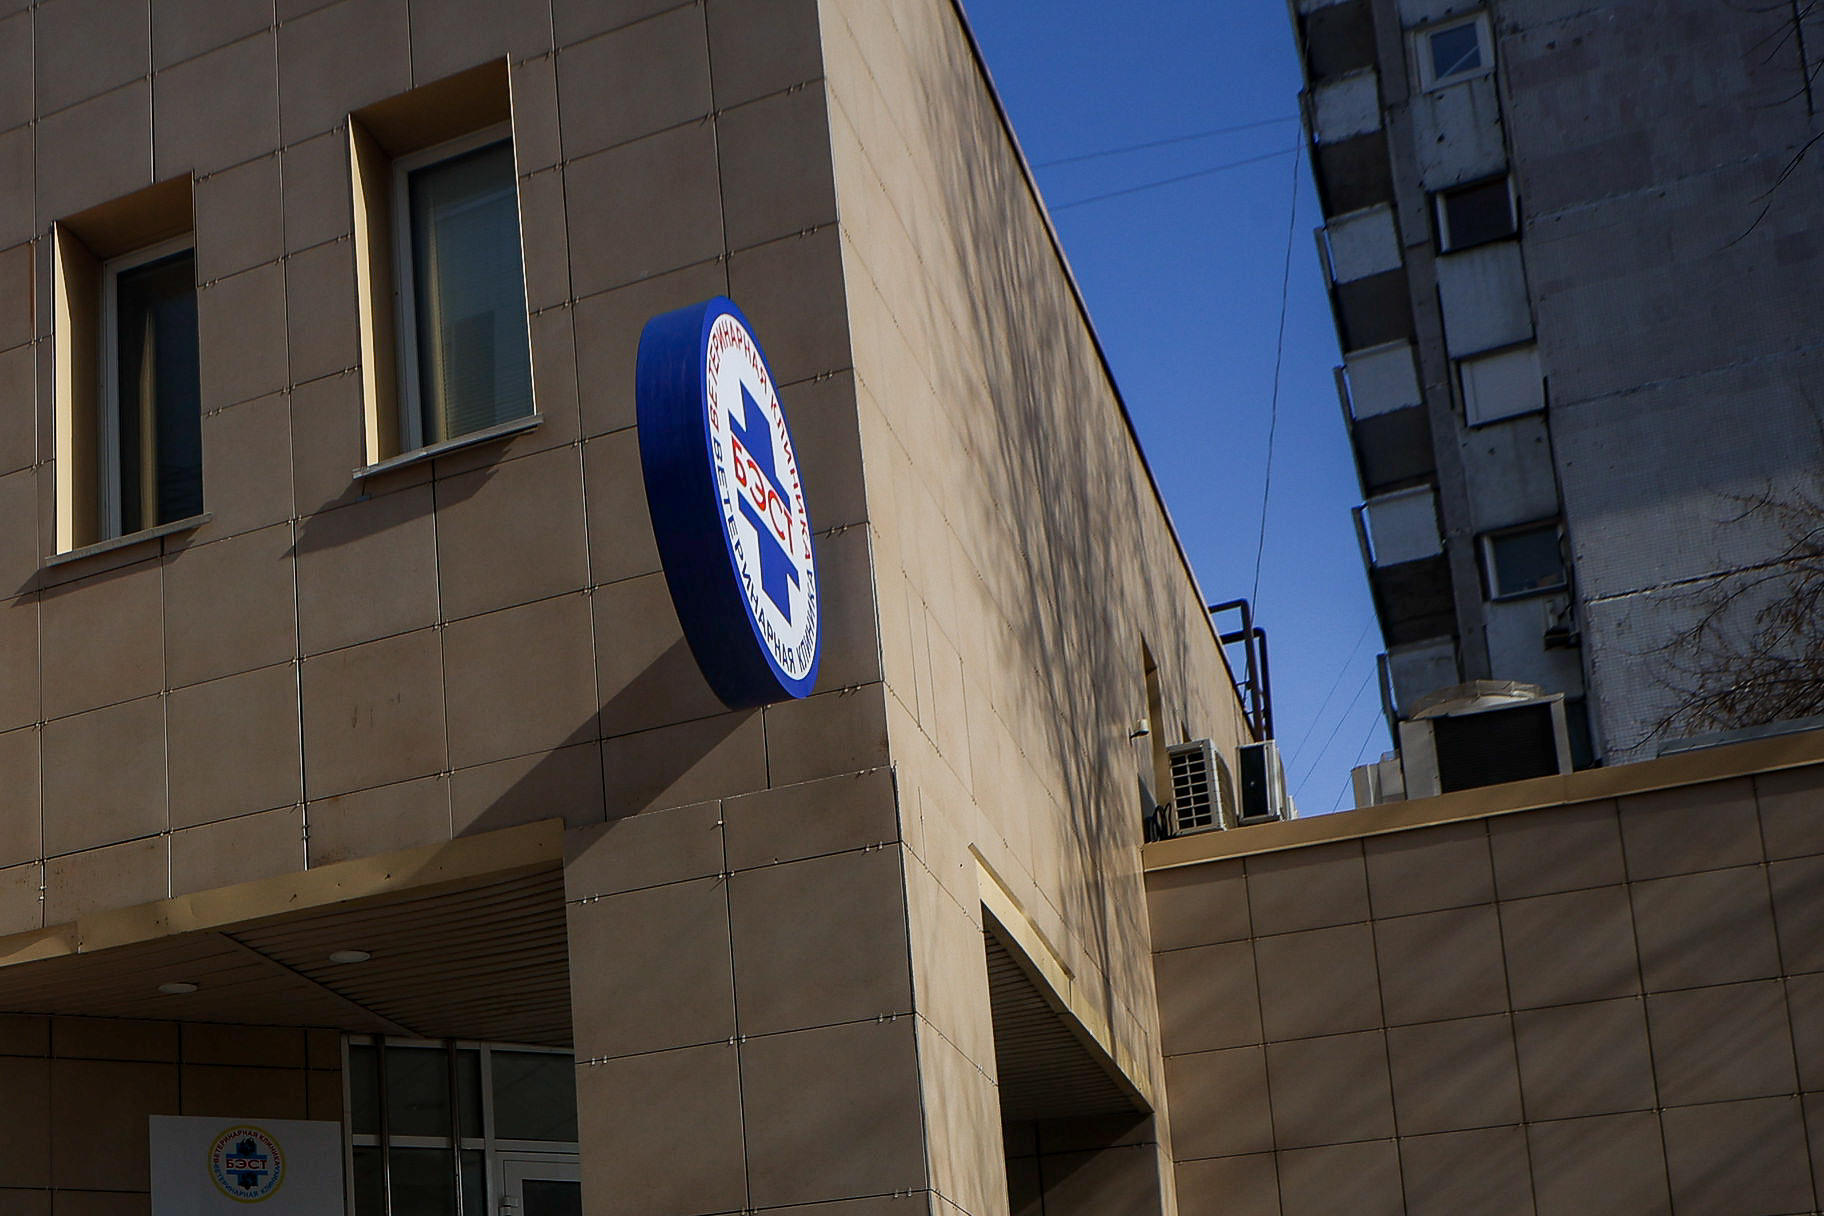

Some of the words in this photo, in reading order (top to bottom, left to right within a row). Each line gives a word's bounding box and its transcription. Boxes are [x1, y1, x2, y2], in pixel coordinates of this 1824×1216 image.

[708, 319, 767, 433] ВЕТЕРИНАРНАЯ
[771, 394, 812, 560] КЛИНИКА
[730, 432, 795, 556] БЭСТ
[713, 436, 796, 674] ВЕТЕРИНАРНАЯ
[226, 1158, 267, 1170] БЭСТ
